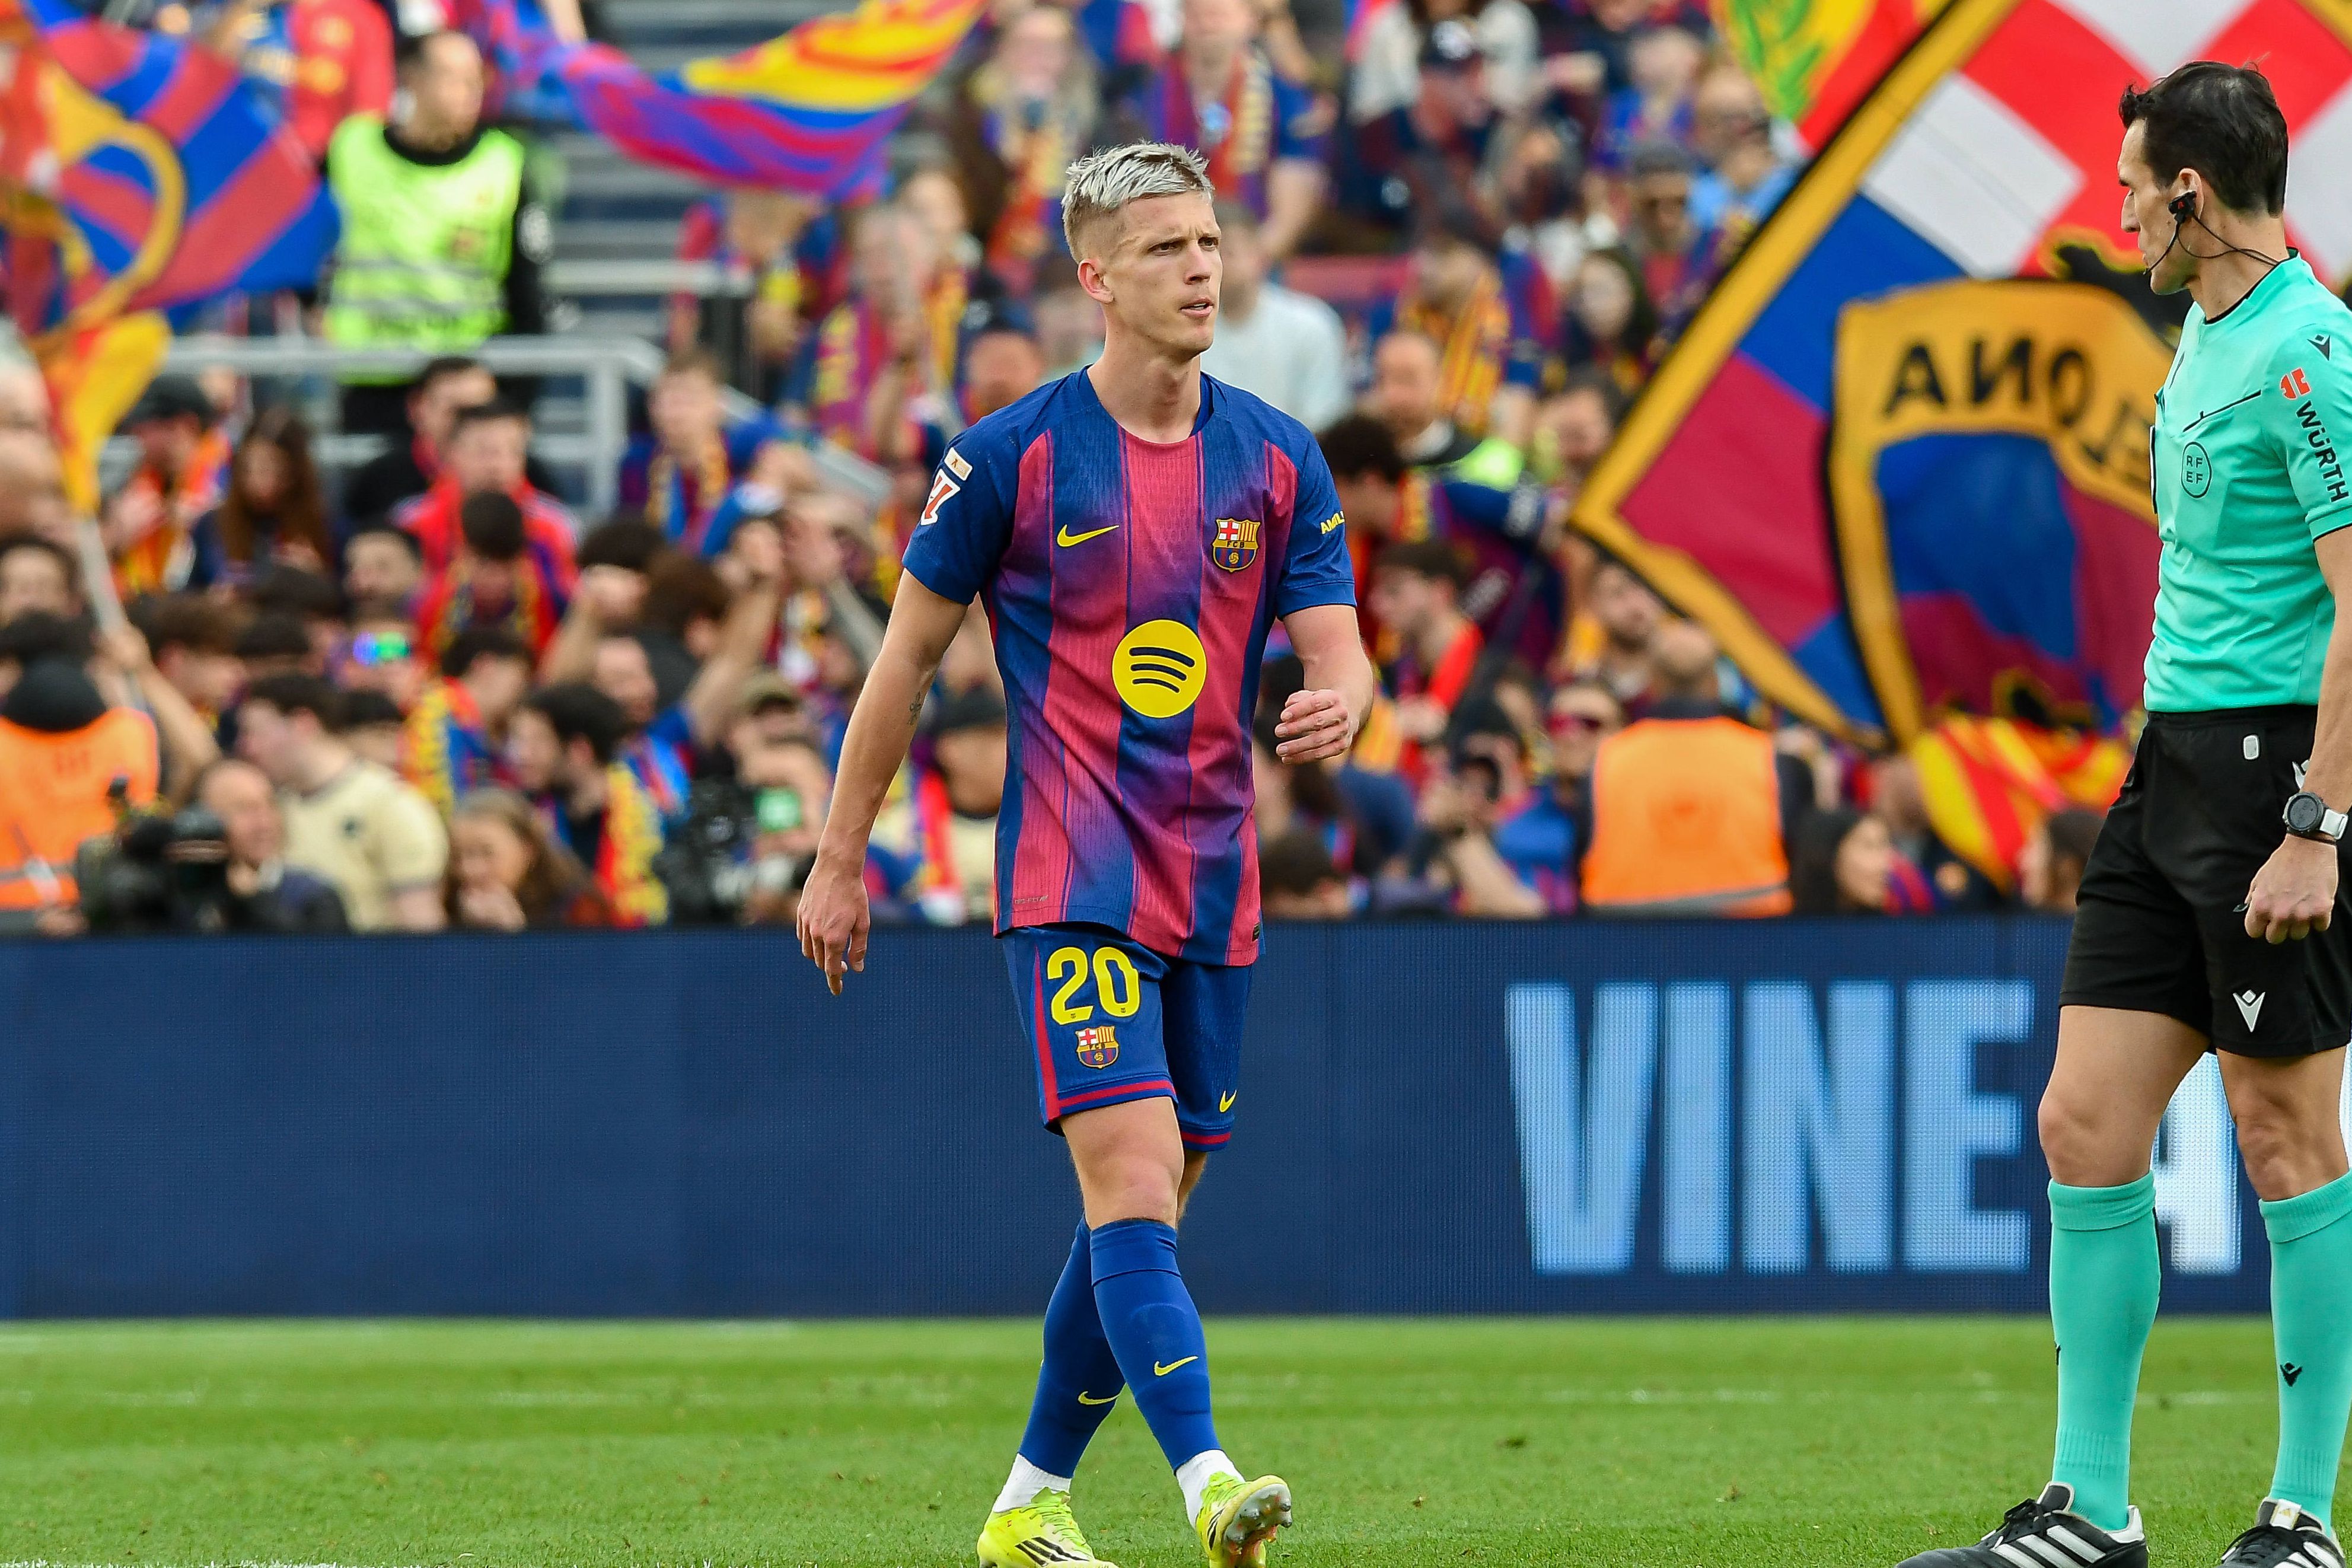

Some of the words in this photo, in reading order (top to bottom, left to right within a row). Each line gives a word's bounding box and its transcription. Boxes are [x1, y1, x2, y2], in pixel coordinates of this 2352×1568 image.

[2296, 400, 2349, 503] WÜRTH
[1047, 946, 1141, 1025] 20
[1505, 979, 2035, 1274] VINE
